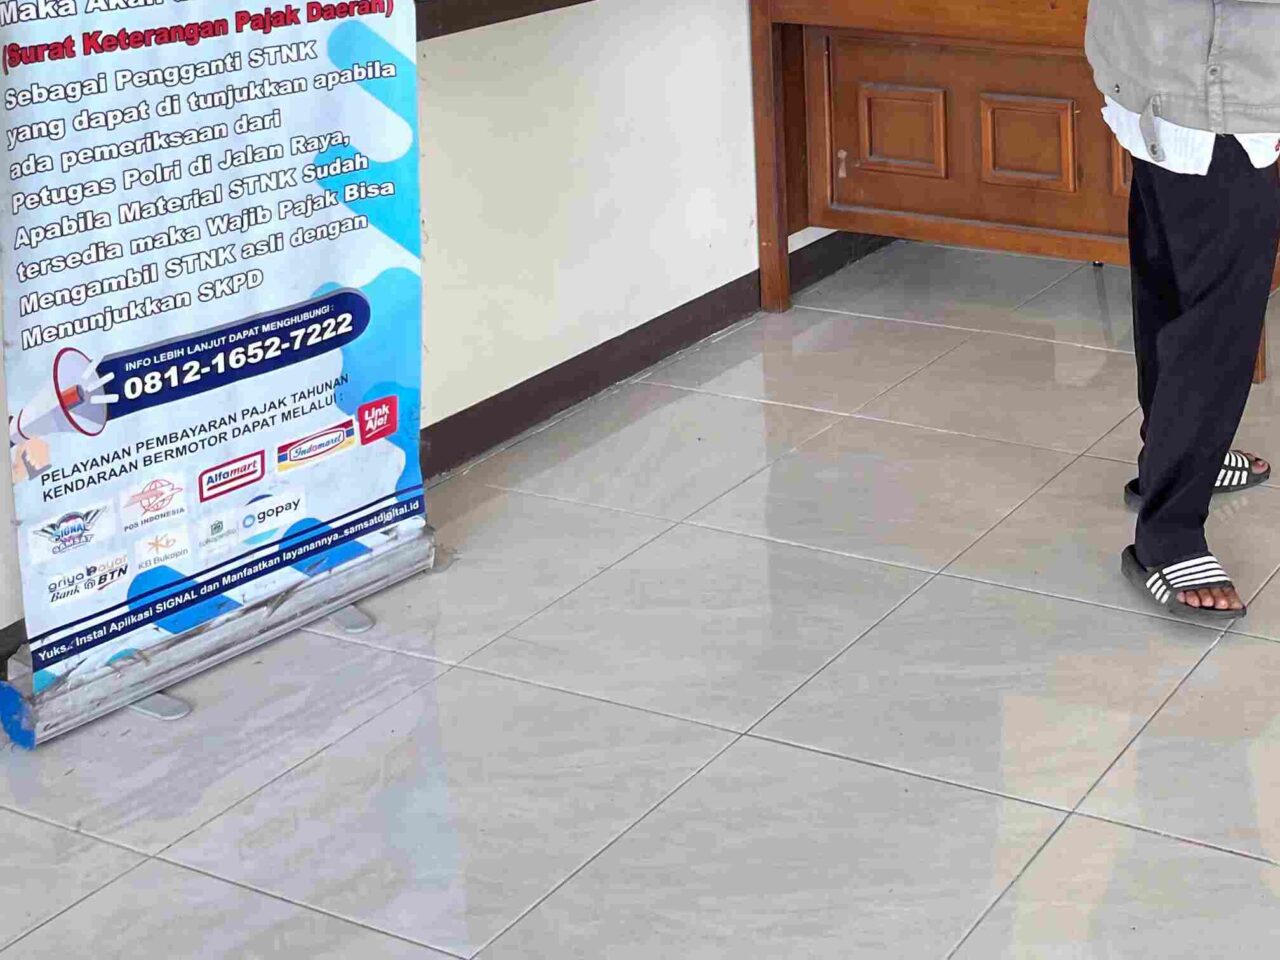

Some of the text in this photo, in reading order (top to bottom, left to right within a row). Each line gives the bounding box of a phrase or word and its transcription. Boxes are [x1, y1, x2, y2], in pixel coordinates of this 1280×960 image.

[1, 35, 76, 76] (Surat
[82, 17, 229, 57] Keterangan
[235, 6, 300, 36] Pajak
[5, 39, 318, 110] Sebagai Pengganti STNK
[6, 60, 397, 150] yang dapat di tunjukkan apabila
[9, 108, 281, 181] ada pemeriksaan dari
[11, 128, 351, 216] Petugas Polri di Jalan Raya,
[14, 152, 370, 250] Apabila Material STNK Sudah
[16, 180, 395, 283] tersedia maka Wajib Pajak Bisa
[19, 214, 368, 317] Mengambil STNK asli dengan
[21, 268, 264, 350] Menunjukkan SKPD
[125, 356, 151, 372] INFO
[153, 347, 185, 365] LEBIH
[186, 336, 227, 356] LANJUT
[228, 326, 260, 343] DAPAT
[261, 306, 330, 333] MENGHUBUNGI
[124, 312, 353, 400] 0812-1652-7222
[41, 373, 349, 486] PELAYANAN PEMBAYARAN PAJAK TAHUNAN
[42, 463, 139, 502] KENDARAAN
[143, 431, 228, 468] BERMOTOR
[232, 416, 277, 440] DAPAT
[281, 394, 337, 423] MELALUI
[206, 459, 259, 486] Alfamart
[257, 498, 300, 523] gopay
[124, 507, 185, 532] POS INDONESIA
[50, 564, 128, 603] Bank BTN
[75, 626, 107, 646] Instal
[109, 607, 153, 635] Aplikasi
[155, 591, 198, 613] SIGNAL
[200, 580, 220, 595] dan
[222, 557, 281, 586] Manfaatkan
